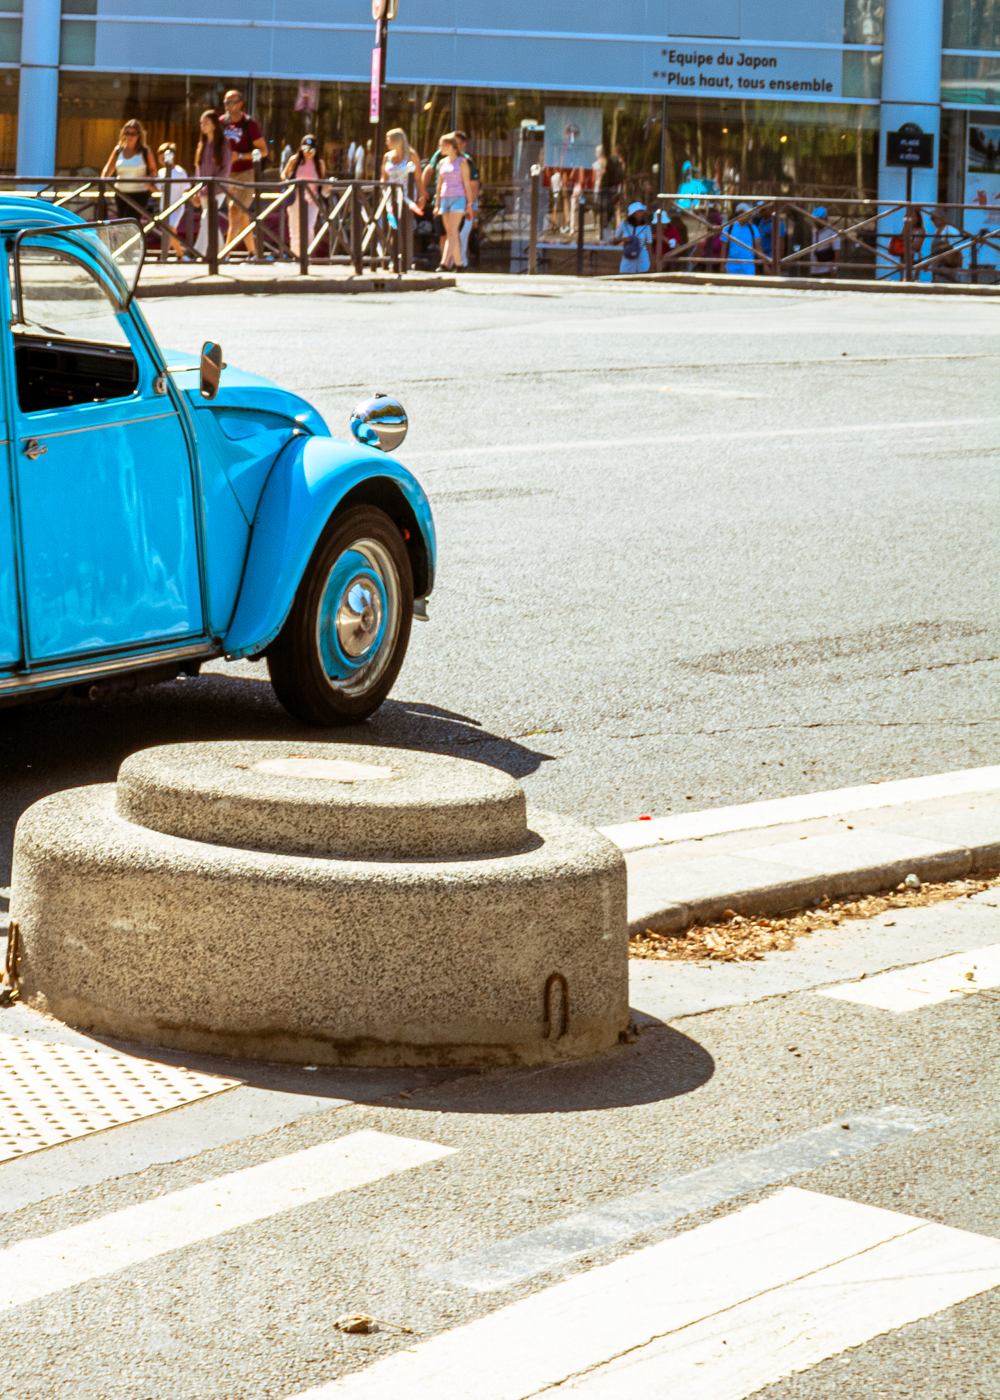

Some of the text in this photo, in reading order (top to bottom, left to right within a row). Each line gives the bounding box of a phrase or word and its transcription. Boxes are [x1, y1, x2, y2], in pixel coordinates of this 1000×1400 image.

[716, 52, 734, 66] du
[736, 52, 778, 70] Japon
[699, 73, 734, 89] haut,
[737, 76, 766, 89] tous
[769, 78, 834, 93] ensemble
